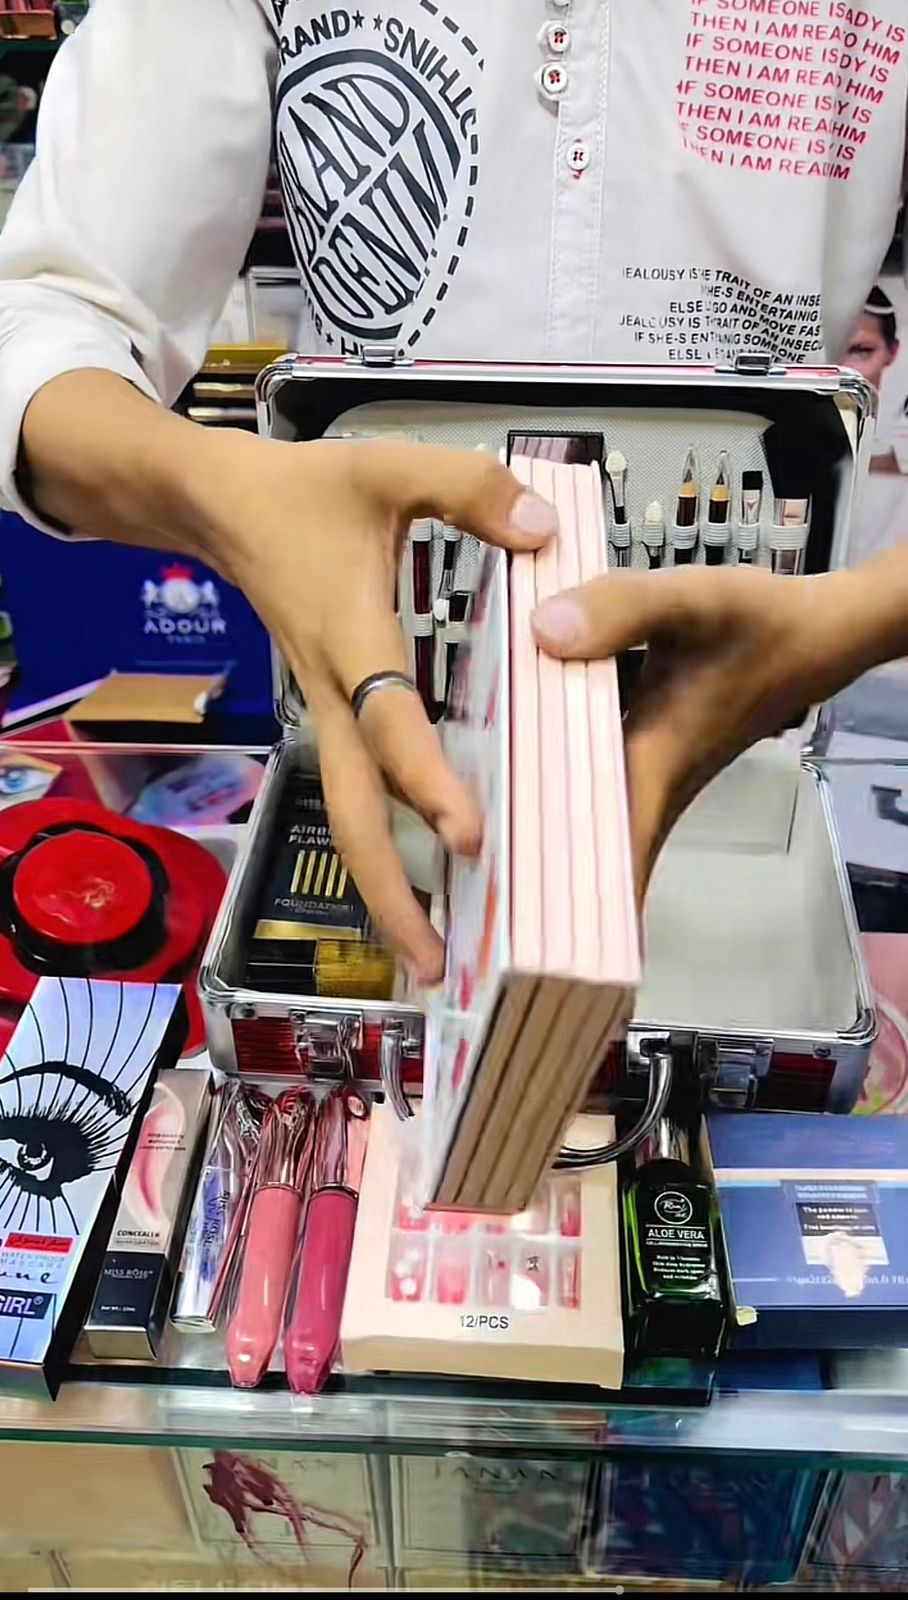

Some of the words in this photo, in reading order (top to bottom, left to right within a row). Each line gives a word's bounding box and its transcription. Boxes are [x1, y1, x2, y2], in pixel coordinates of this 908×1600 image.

[717, 0, 821, 17] SOMEONE
[829, 2, 846, 18] IS
[886, 24, 905, 42] IS
[690, 12, 747, 33] THEN
[755, 19, 759, 34] I
[765, 21, 798, 39] AM
[863, 38, 900, 65] HIM
[686, 32, 704, 48] IF
[712, 35, 813, 62] SOMEONE
[822, 48, 839, 64] IS
[870, 64, 888, 83] IS
[685, 55, 741, 77] THEN
[747, 63, 752, 79] I
[757, 65, 790, 83] AM
[845, 78, 884, 104] HIM
[677, 80, 698, 95] IF
[704, 82, 808, 109] SOMEONE
[815, 95, 832, 112] IS
[852, 106, 872, 123] IS
[677, 102, 732, 123] THEN
[738, 109, 743, 124] I
[748, 111, 781, 129] AM
[696, 125, 800, 153] SOMEONE
[808, 139, 825, 154] IS
[730, 153, 735, 167] I
[741, 154, 773, 171] AM
[623, 267, 685, 281] EALOUSY
[715, 269, 751, 290] TRAIT
[753, 287, 772, 300] OF
[773, 293, 793, 306] AN
[669, 300, 703, 314] ELSE
[730, 302, 757, 318] AND
[759, 314, 797, 336] MOVE
[688, 316, 701, 329] IS
[742, 319, 760, 331] OF
[761, 328, 779, 342] AN
[634, 331, 645, 343] IF
[648, 332, 686, 345] SHE-S
[743, 333, 806, 364] SOMEONE
[274, 897, 354, 912] FOUNDAT
[648, 1228, 676, 1238] ALOE
[677, 1230, 705, 1240] VERA
[460, 1315, 509, 1330] 12/PCS
